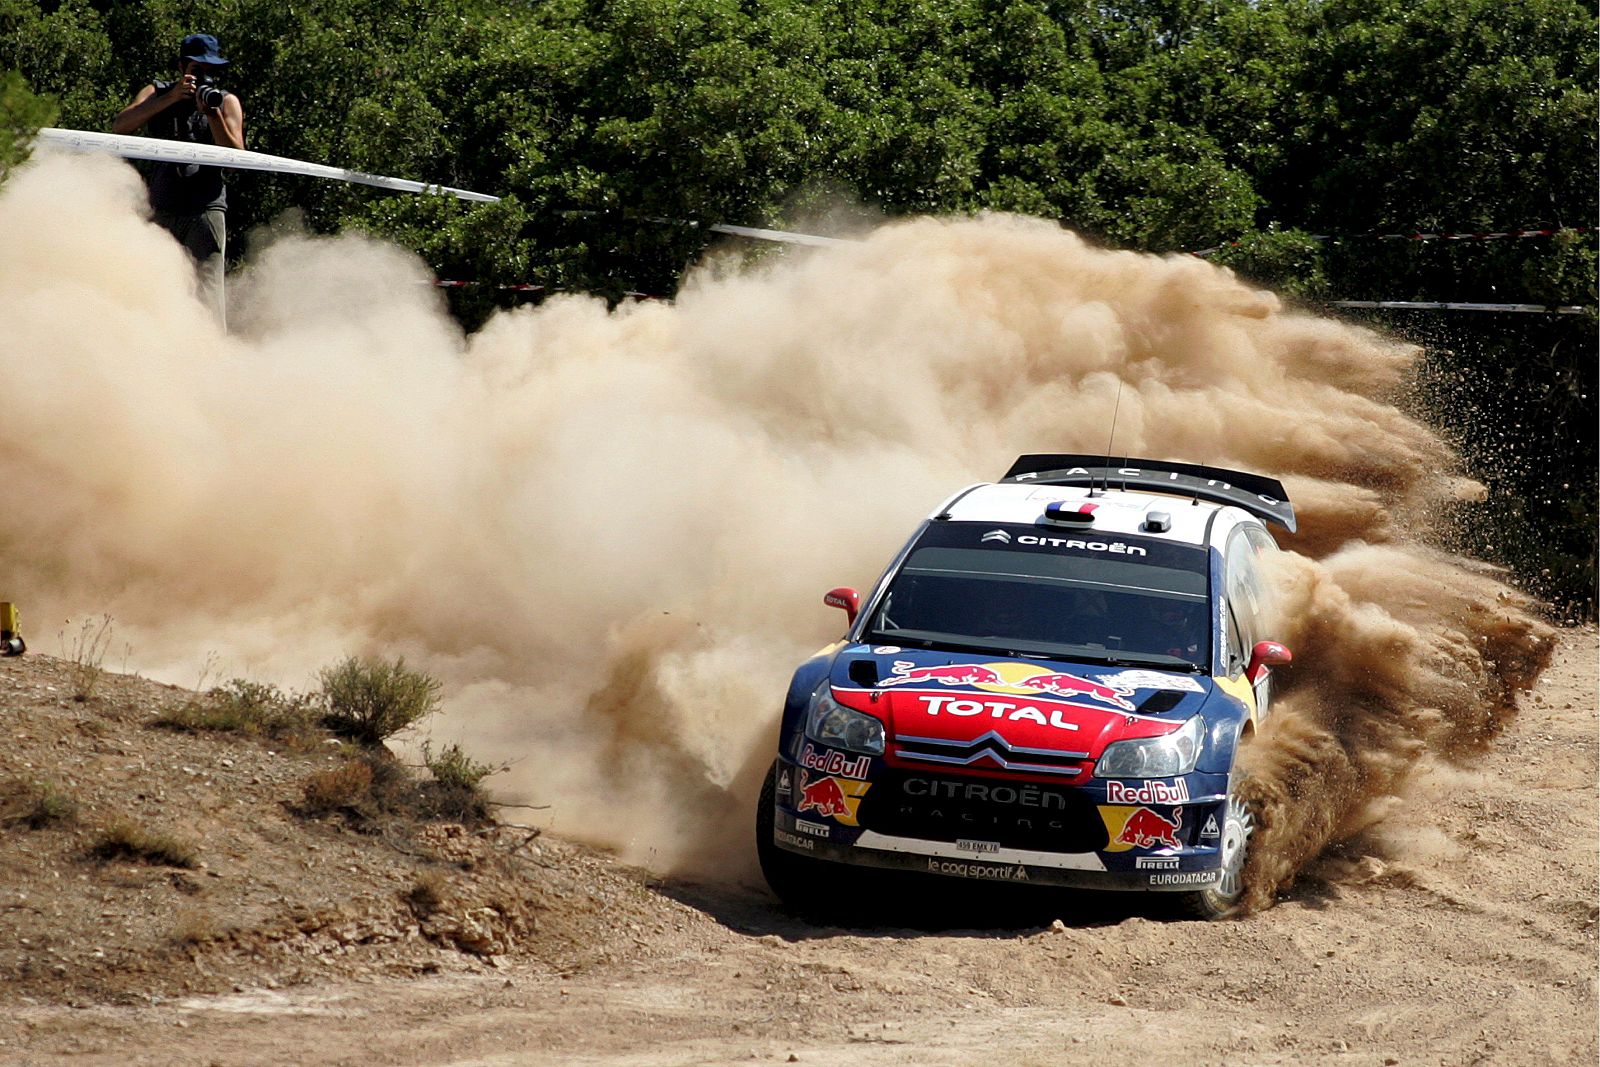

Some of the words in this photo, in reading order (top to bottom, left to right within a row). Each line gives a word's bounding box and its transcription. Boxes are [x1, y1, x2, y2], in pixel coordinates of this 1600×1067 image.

[827, 595, 848, 606] TOTAL
[918, 696, 1079, 731] TOTAL
[801, 744, 829, 768] Red
[827, 749, 871, 780] Bull
[1107, 780, 1153, 804] Red
[1152, 777, 1190, 805] Bull
[795, 818, 830, 838] PIRELLI
[928, 857, 939, 871] le
[941, 862, 967, 877] coq
[969, 865, 1013, 879] sportif
[1135, 856, 1180, 869] PIRELLI
[1150, 872, 1216, 885] EURODATACAR
